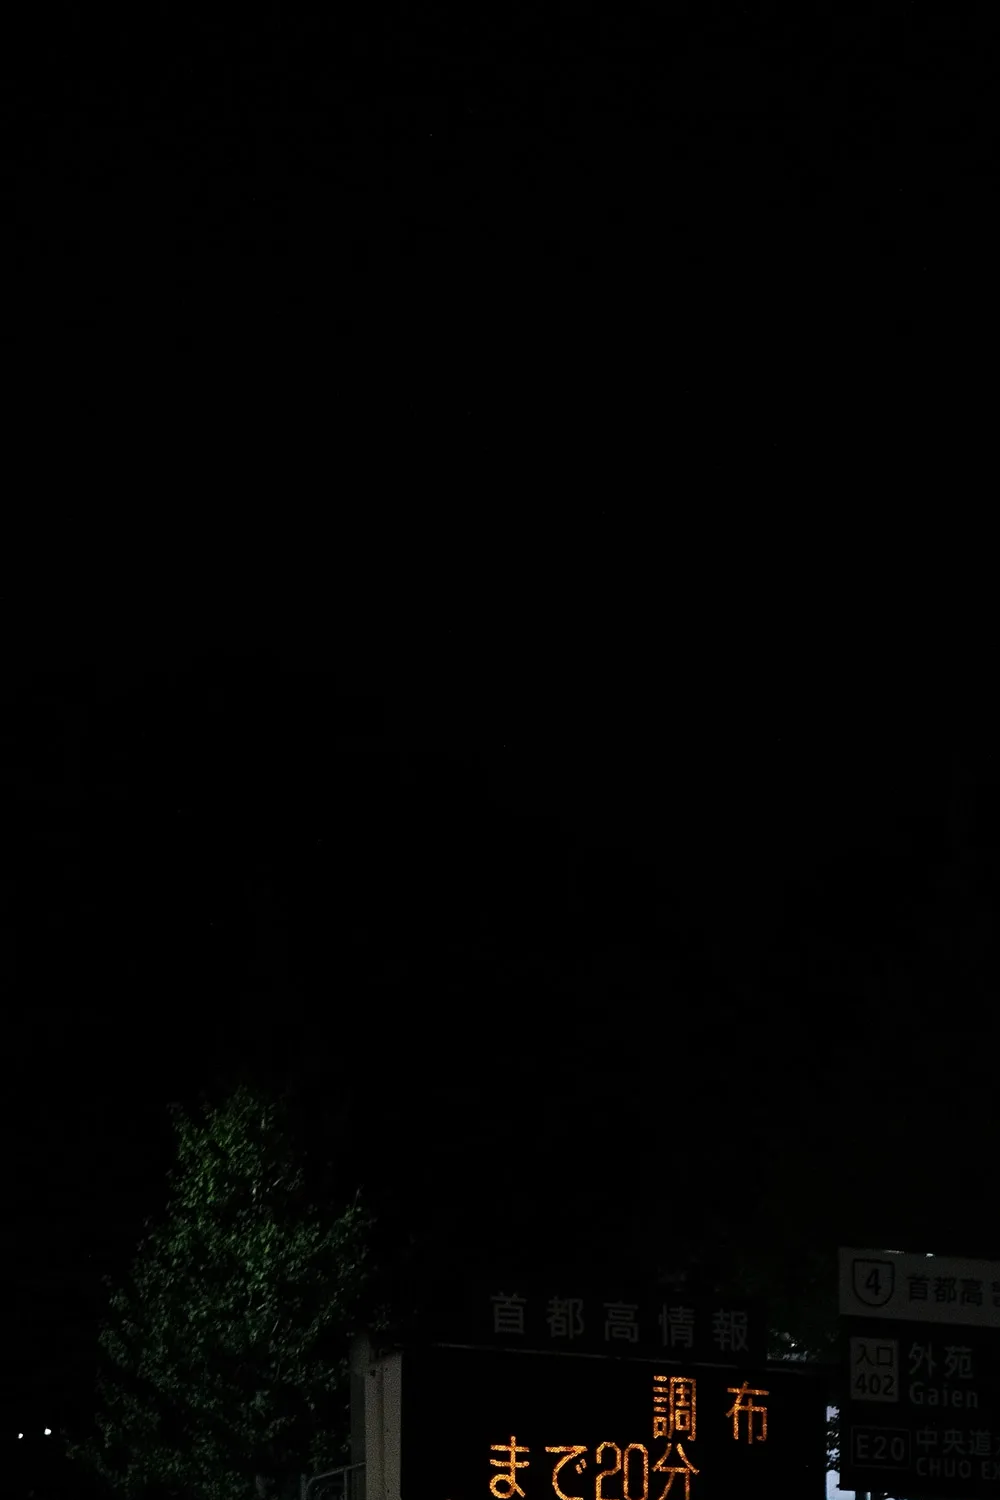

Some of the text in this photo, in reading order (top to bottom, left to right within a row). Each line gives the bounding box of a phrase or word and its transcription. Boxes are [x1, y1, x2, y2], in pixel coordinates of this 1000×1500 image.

[865, 1268, 881, 1296] 4
[907, 1275, 983, 1306] 首都高
[490, 1292, 749, 1352] 首都高情報
[856, 1345, 893, 1367] 入口
[907, 1342, 974, 1379] 外苑
[855, 1374, 894, 1396] 402
[908, 1381, 980, 1409] Gaien
[652, 1374, 770, 1444] 調布
[855, 1433, 905, 1462] E20
[916, 1456, 972, 1479] CHUO
